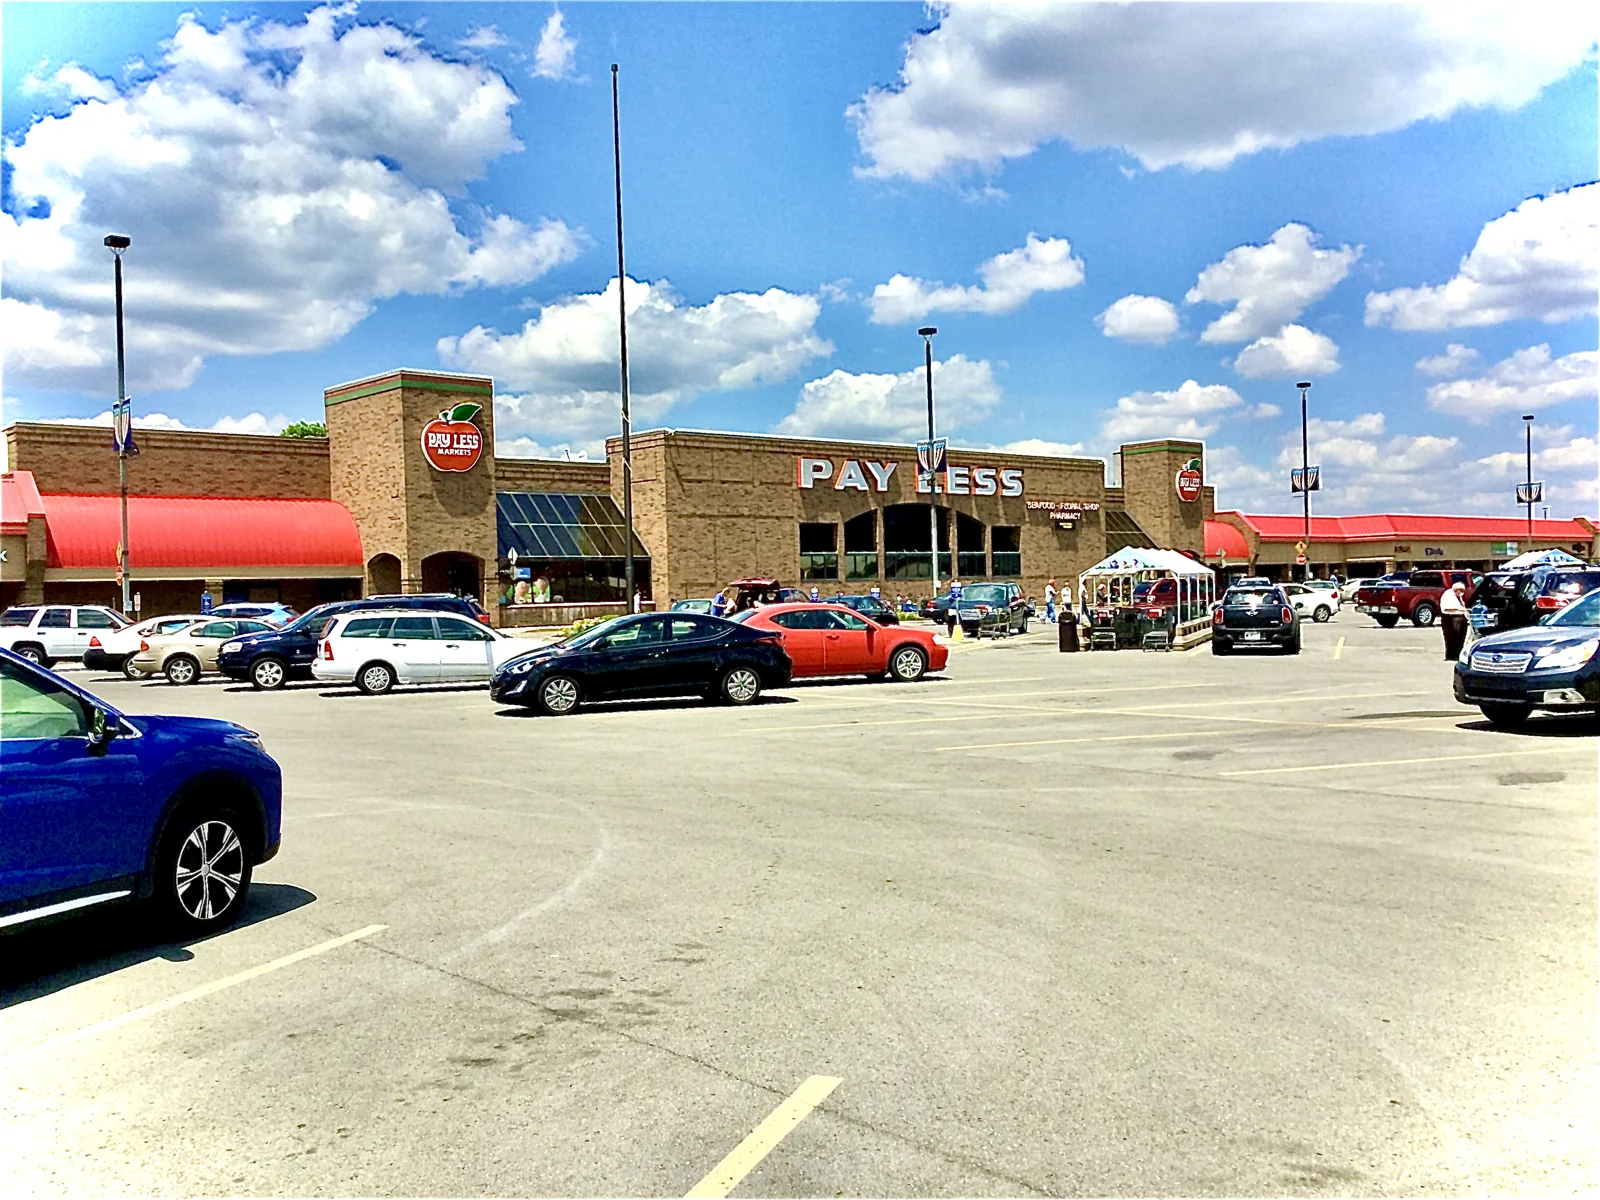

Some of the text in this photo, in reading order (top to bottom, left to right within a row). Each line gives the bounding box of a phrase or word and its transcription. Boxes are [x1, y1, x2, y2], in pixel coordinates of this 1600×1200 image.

[428, 432, 479, 449] PAY LESS
[437, 448, 471, 456] MARKETS
[797, 457, 1024, 497] PAY LESS
[1050, 511, 1081, 520] PHARMACY
